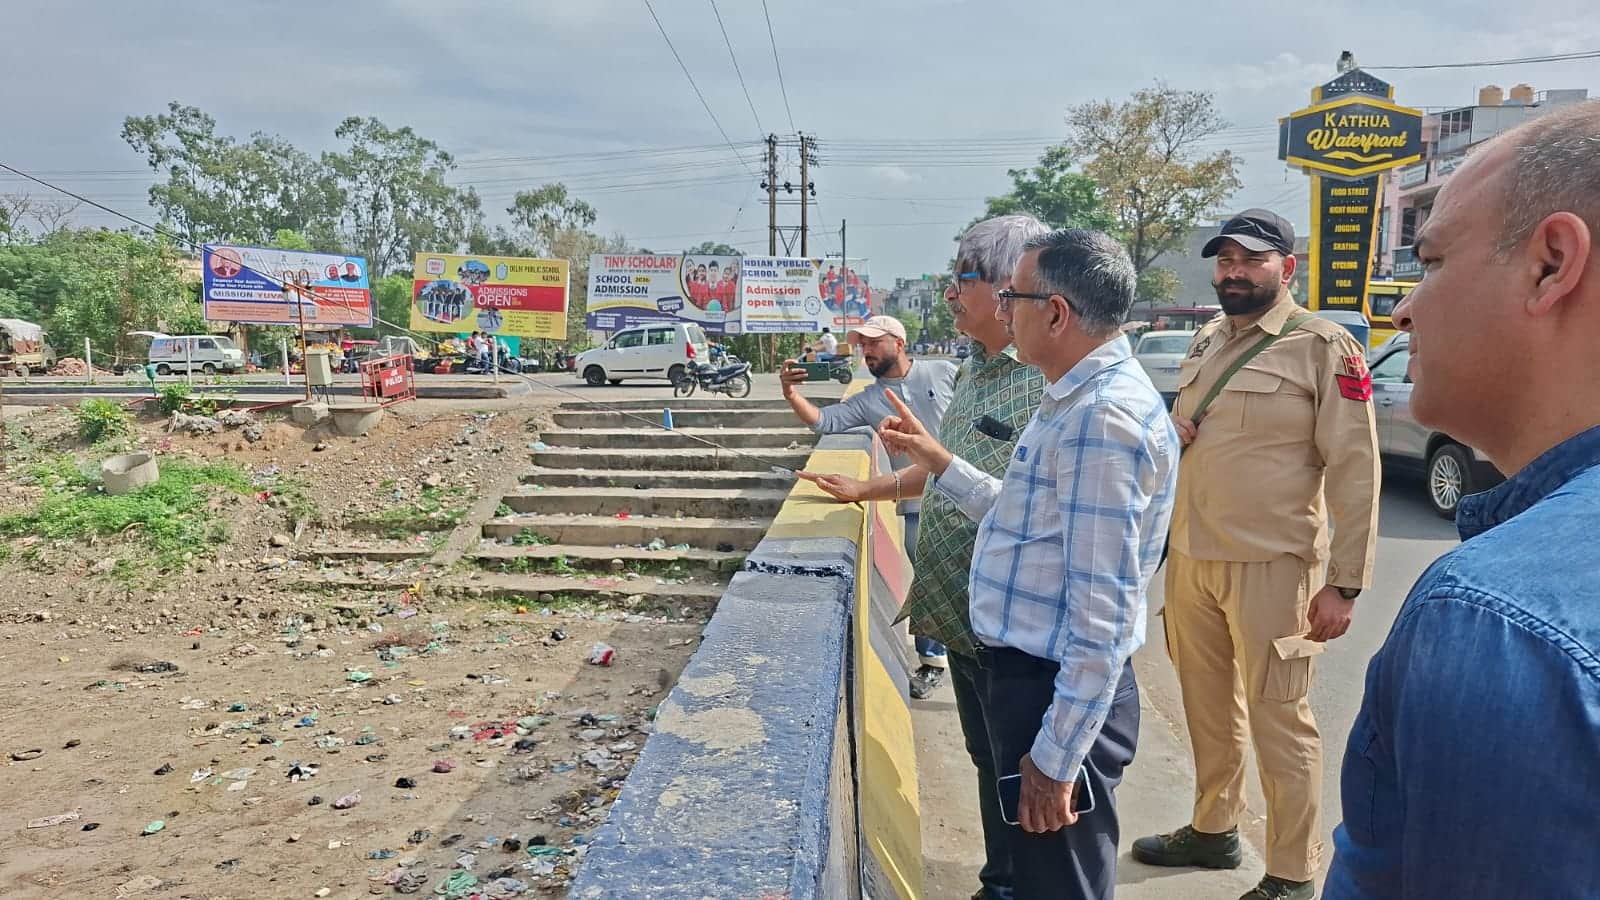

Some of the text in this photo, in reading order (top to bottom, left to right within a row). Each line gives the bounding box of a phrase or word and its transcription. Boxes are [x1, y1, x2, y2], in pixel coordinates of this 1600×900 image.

[1325, 112, 1390, 127] KATHUA
[1307, 128, 1407, 152] Waterfront
[1331, 188, 1369, 196] FOOD STREET
[1335, 224, 1360, 232] JOGGING
[1333, 242, 1360, 251] SKATING
[604, 256, 677, 269] TINY SCHOLARS
[1332, 260, 1358, 269] CYCLING
[596, 275, 632, 284] SCHOOL
[1336, 279, 1352, 287] YOGA
[213, 289, 253, 298] MISSION
[478, 286, 528, 296] ADMISSIONS
[595, 285, 648, 294] ADMISSION
[746, 285, 801, 295] Admission
[478, 295, 511, 306] OPEN
[747, 299, 774, 308] open
[1327, 296, 1358, 304] WALKWAY
